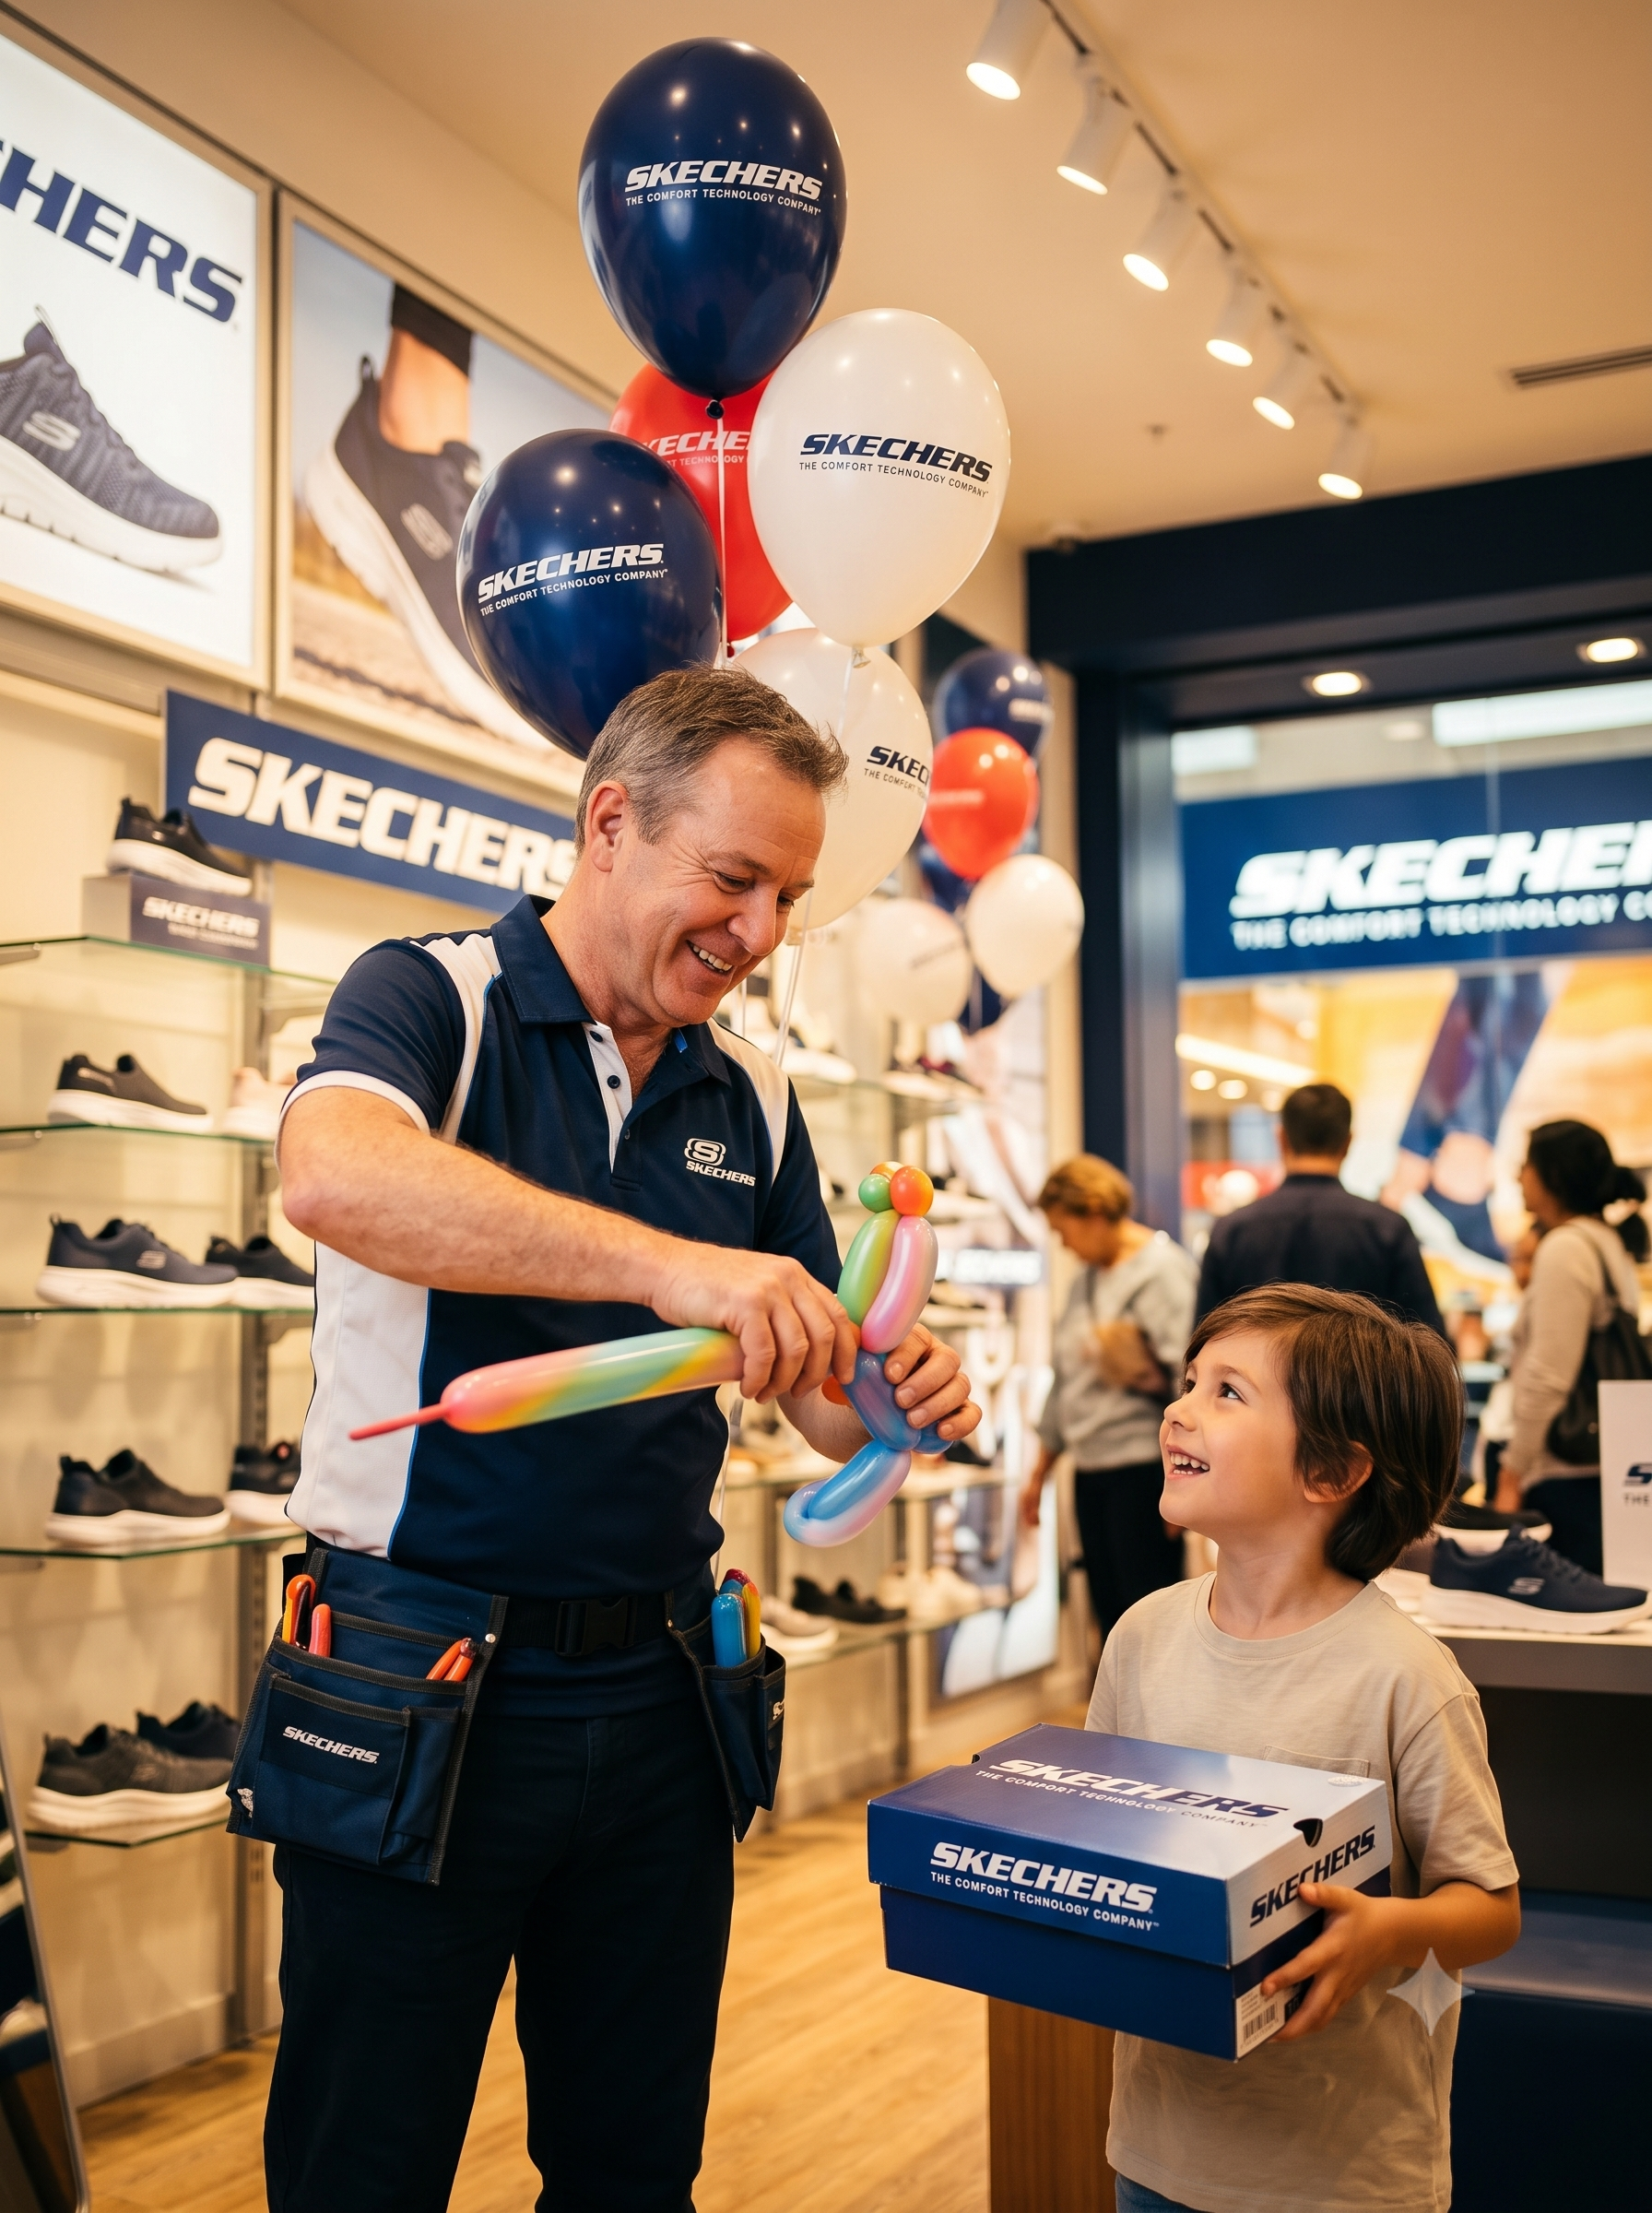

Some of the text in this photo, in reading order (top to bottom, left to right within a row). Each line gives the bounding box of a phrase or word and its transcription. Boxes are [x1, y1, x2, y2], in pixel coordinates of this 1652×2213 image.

[625, 160, 822, 200] SKECHERS
[626, 195, 643, 207] THE
[647, 189, 698, 203] COMFORT
[703, 188, 774, 203] TECHNOLOGY
[0, 141, 242, 323] HERS
[679, 456, 744, 467] TECHNOOGY
[799, 462, 817, 470] THE
[821, 461, 873, 472] COMFORT
[878, 465, 946, 484] TECHNOLOGY
[800, 433, 993, 482] SKECHERS
[478, 543, 664, 604] SKECHERS
[495, 589, 537, 610] COMFORT
[540, 574, 611, 596] TECHNOLOGY
[615, 569, 665, 582] COMPANY
[864, 768, 880, 780] THE
[1426, 893, 1620, 937] TECHNOLOGY
[686, 1160, 756, 1187] SKECHERS
[282, 1725, 380, 1764] SKECHERS
[989, 1759, 1290, 1818] SKECHERS
[930, 1841, 1157, 1912] SKECHERS
[930, 1871, 1153, 1931] THE COMFORT TECHNOLOGY COMPANY
